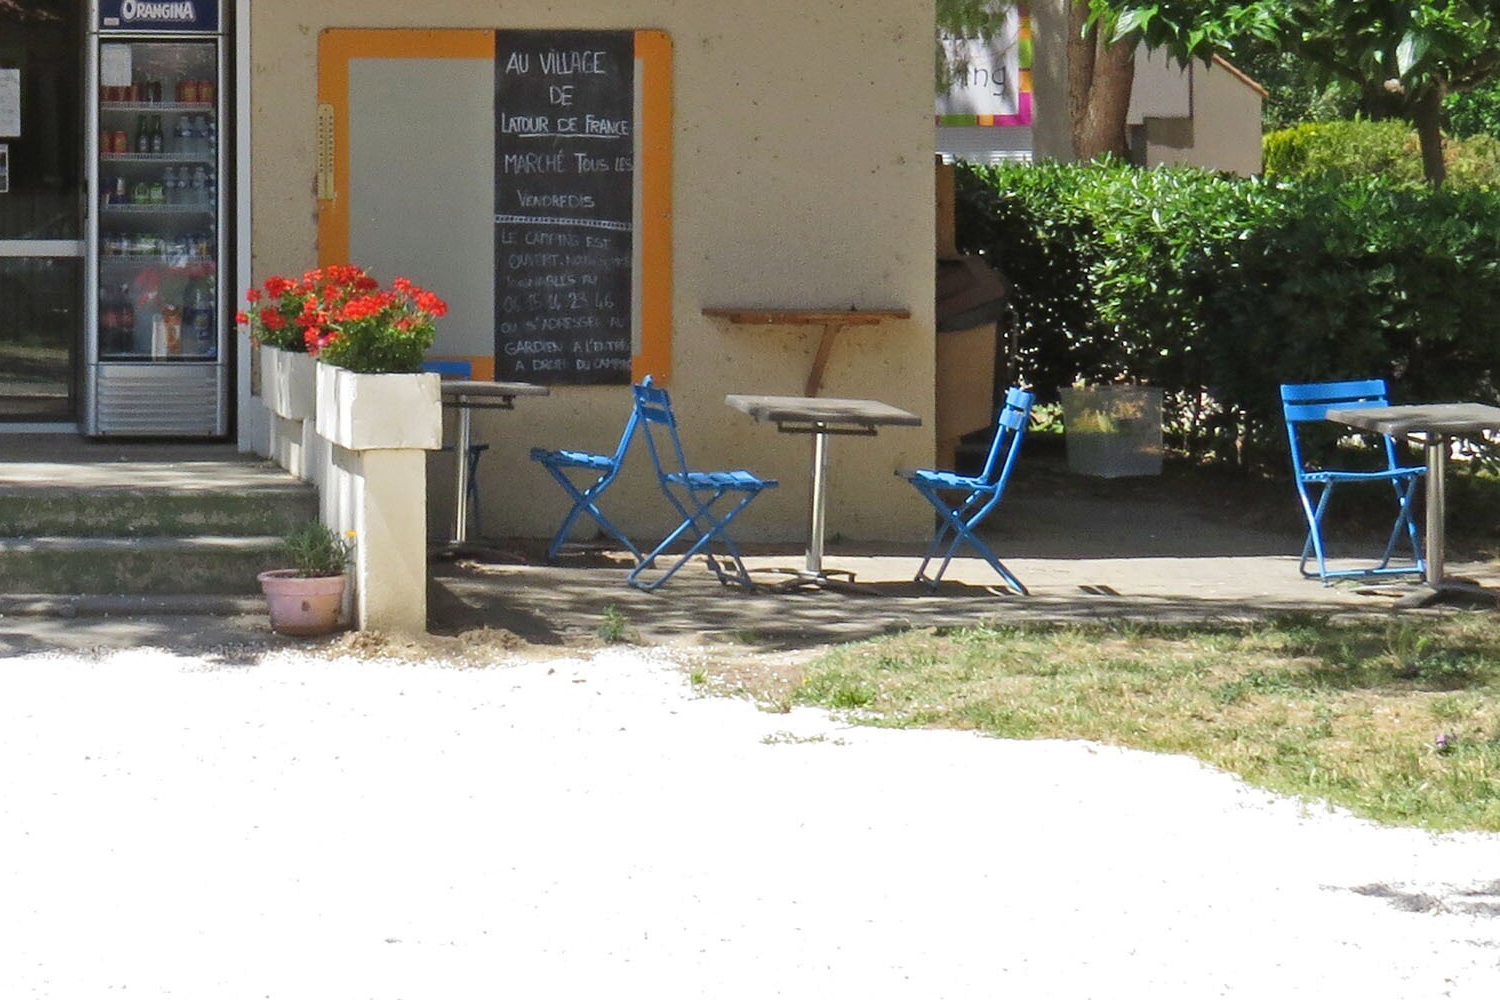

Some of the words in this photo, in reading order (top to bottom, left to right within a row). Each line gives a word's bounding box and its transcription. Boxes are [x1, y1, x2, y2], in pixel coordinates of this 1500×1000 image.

[505, 51, 530, 74] AU
[539, 48, 607, 75] VILLAGE
[549, 85, 574, 106] DE
[557, 117, 579, 132] DE
[586, 114, 629, 136] FRANCE
[504, 149, 565, 174] MARCHÉ
